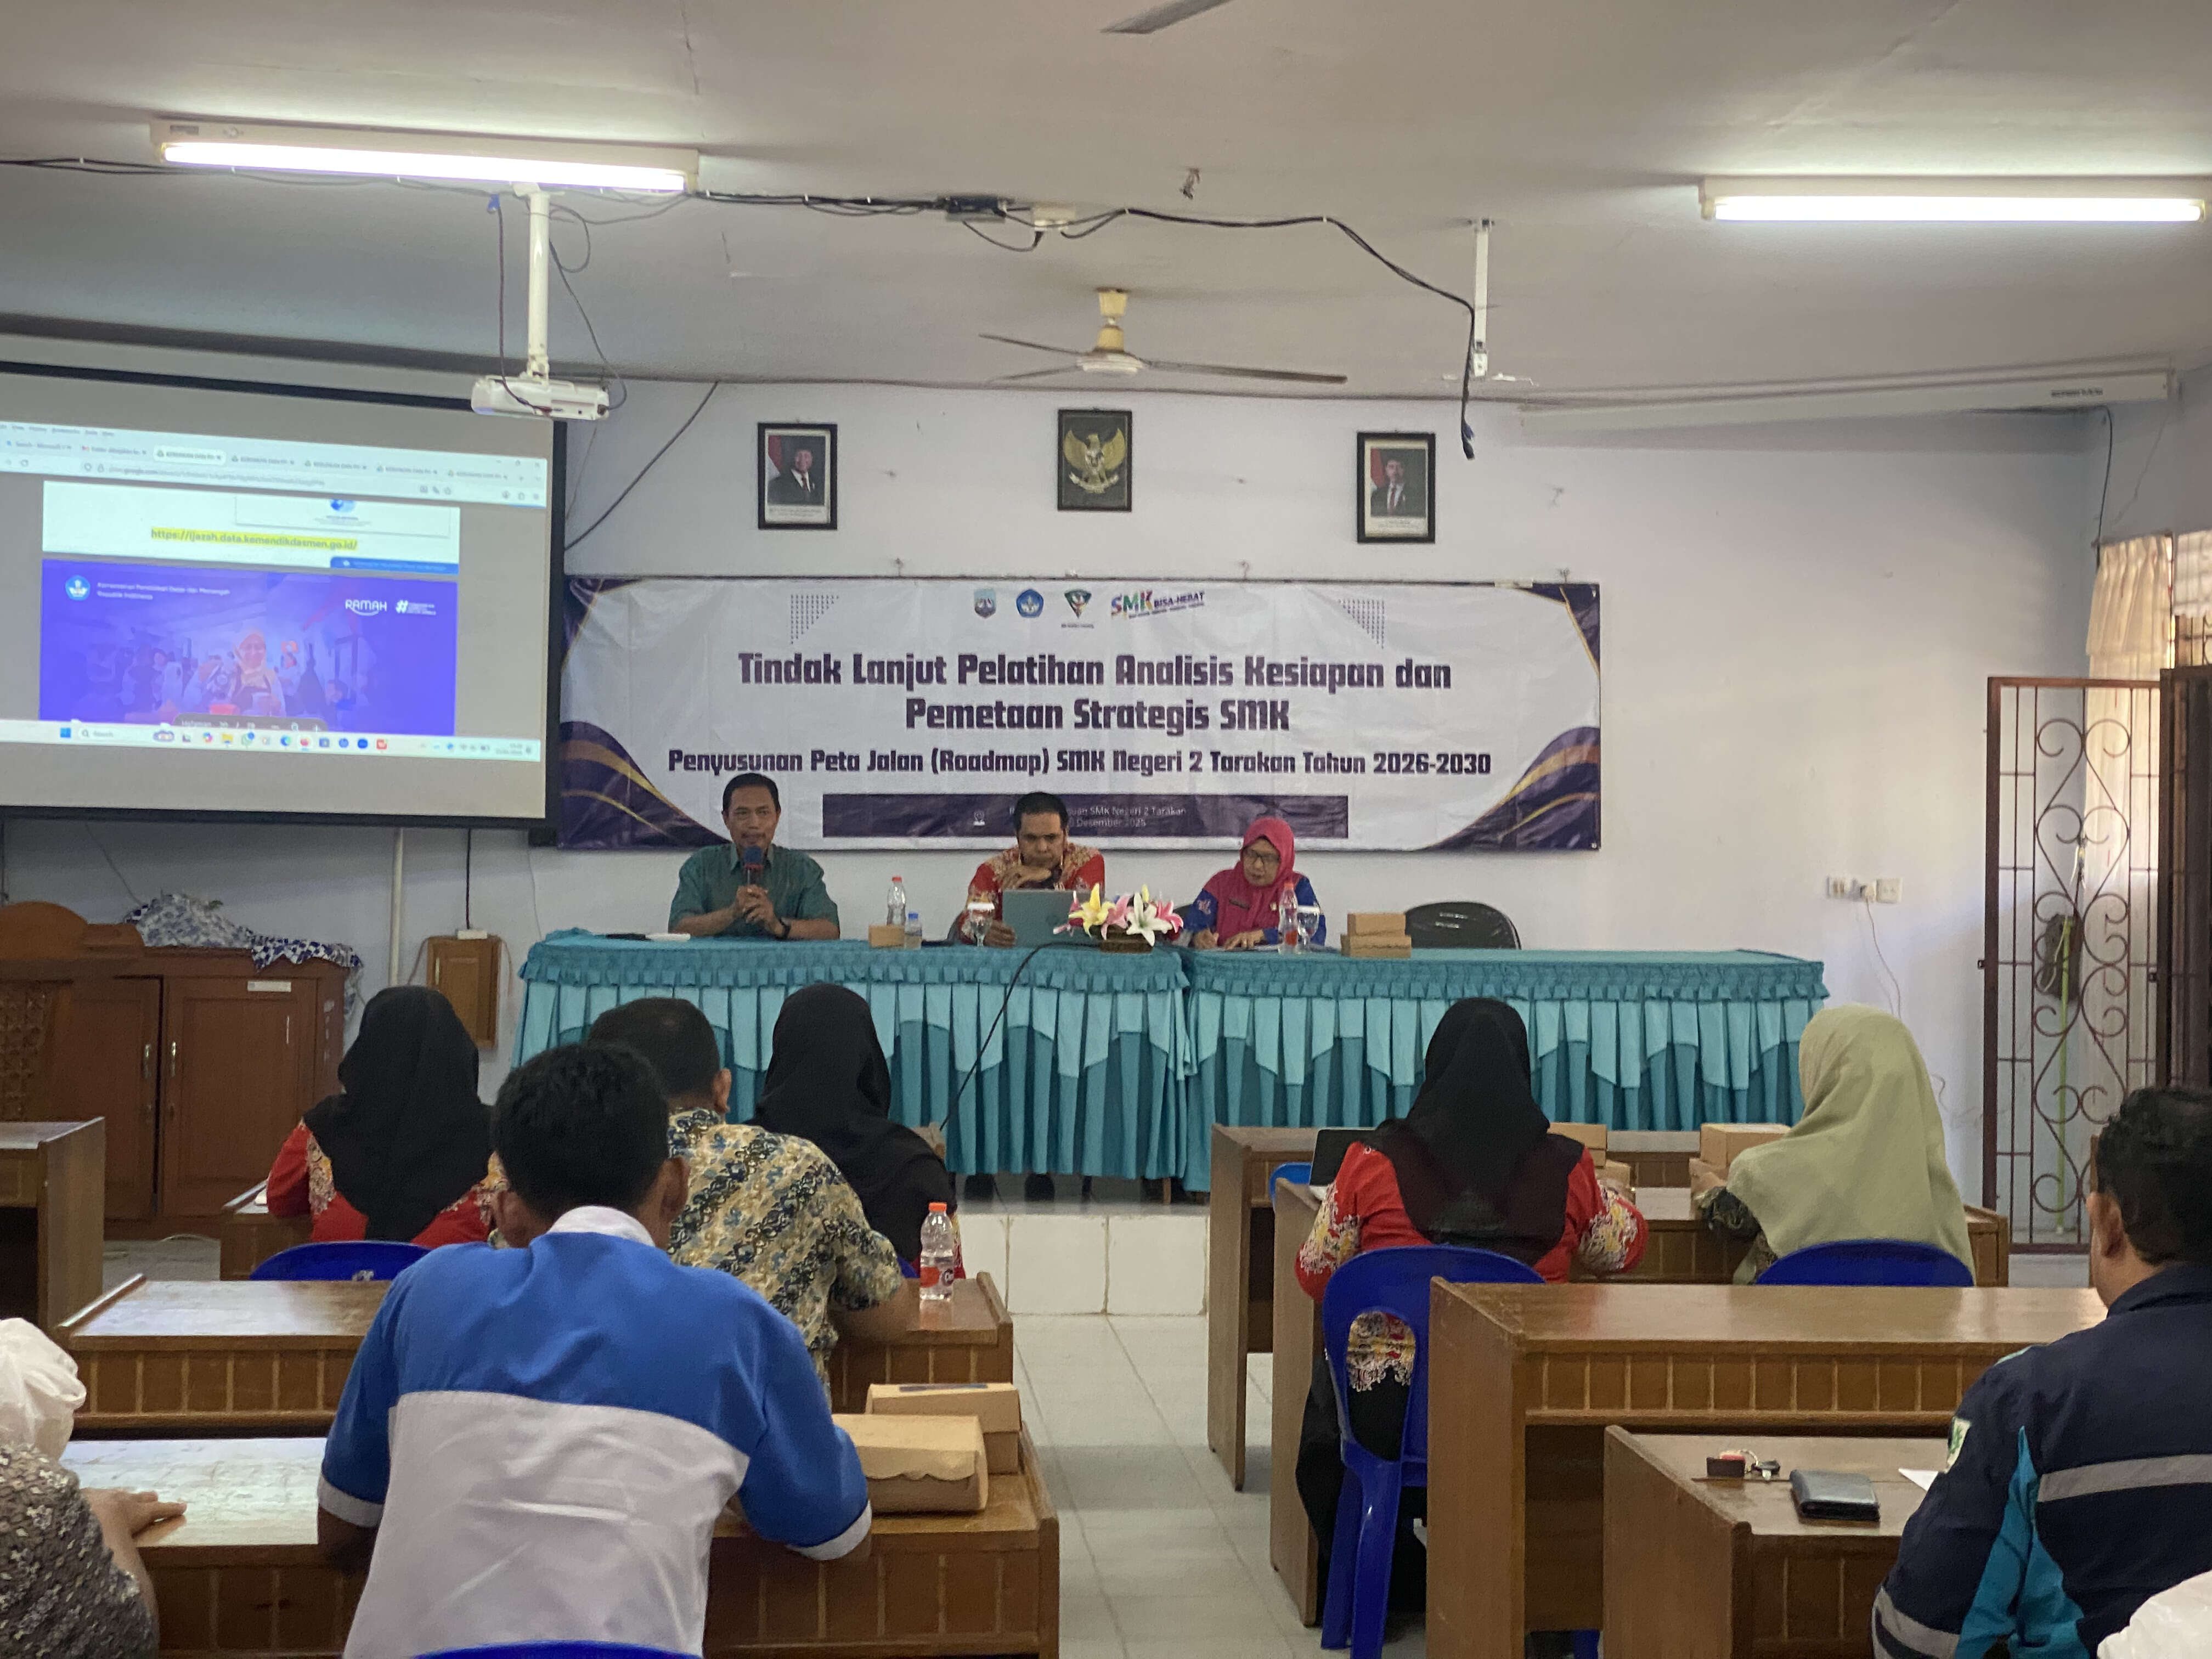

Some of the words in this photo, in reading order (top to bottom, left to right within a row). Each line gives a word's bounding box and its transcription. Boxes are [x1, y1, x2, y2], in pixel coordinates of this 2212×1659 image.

[345, 599, 387, 612] RAMAH
[1111, 589, 1153, 618] SMK
[738, 653, 842, 684] Tindak
[853, 653, 947, 691] Lanjut
[958, 653, 1104, 685] Pelatihan
[1115, 654, 1233, 686] Analisis
[1245, 656, 1384, 695] Kesiapan
[1396, 658, 1452, 689] dan
[906, 698, 1063, 730] Pemetaan
[1074, 698, 1210, 737] Strategis
[1220, 699, 1290, 731] SMK
[669, 749, 803, 776] Penyusunan
[811, 749, 860, 772] Peta
[867, 749, 923, 772] Jalan
[931, 747, 1049, 776] (Roadmap)
[1057, 749, 1105, 772] SMK
[1113, 750, 1182, 777] Negeri
[1189, 751, 1203, 772] 2
[1210, 751, 1296, 774] Tarakan
[1302, 752, 1366, 774] Tahun
[1373, 753, 1491, 775] 2026-2030
